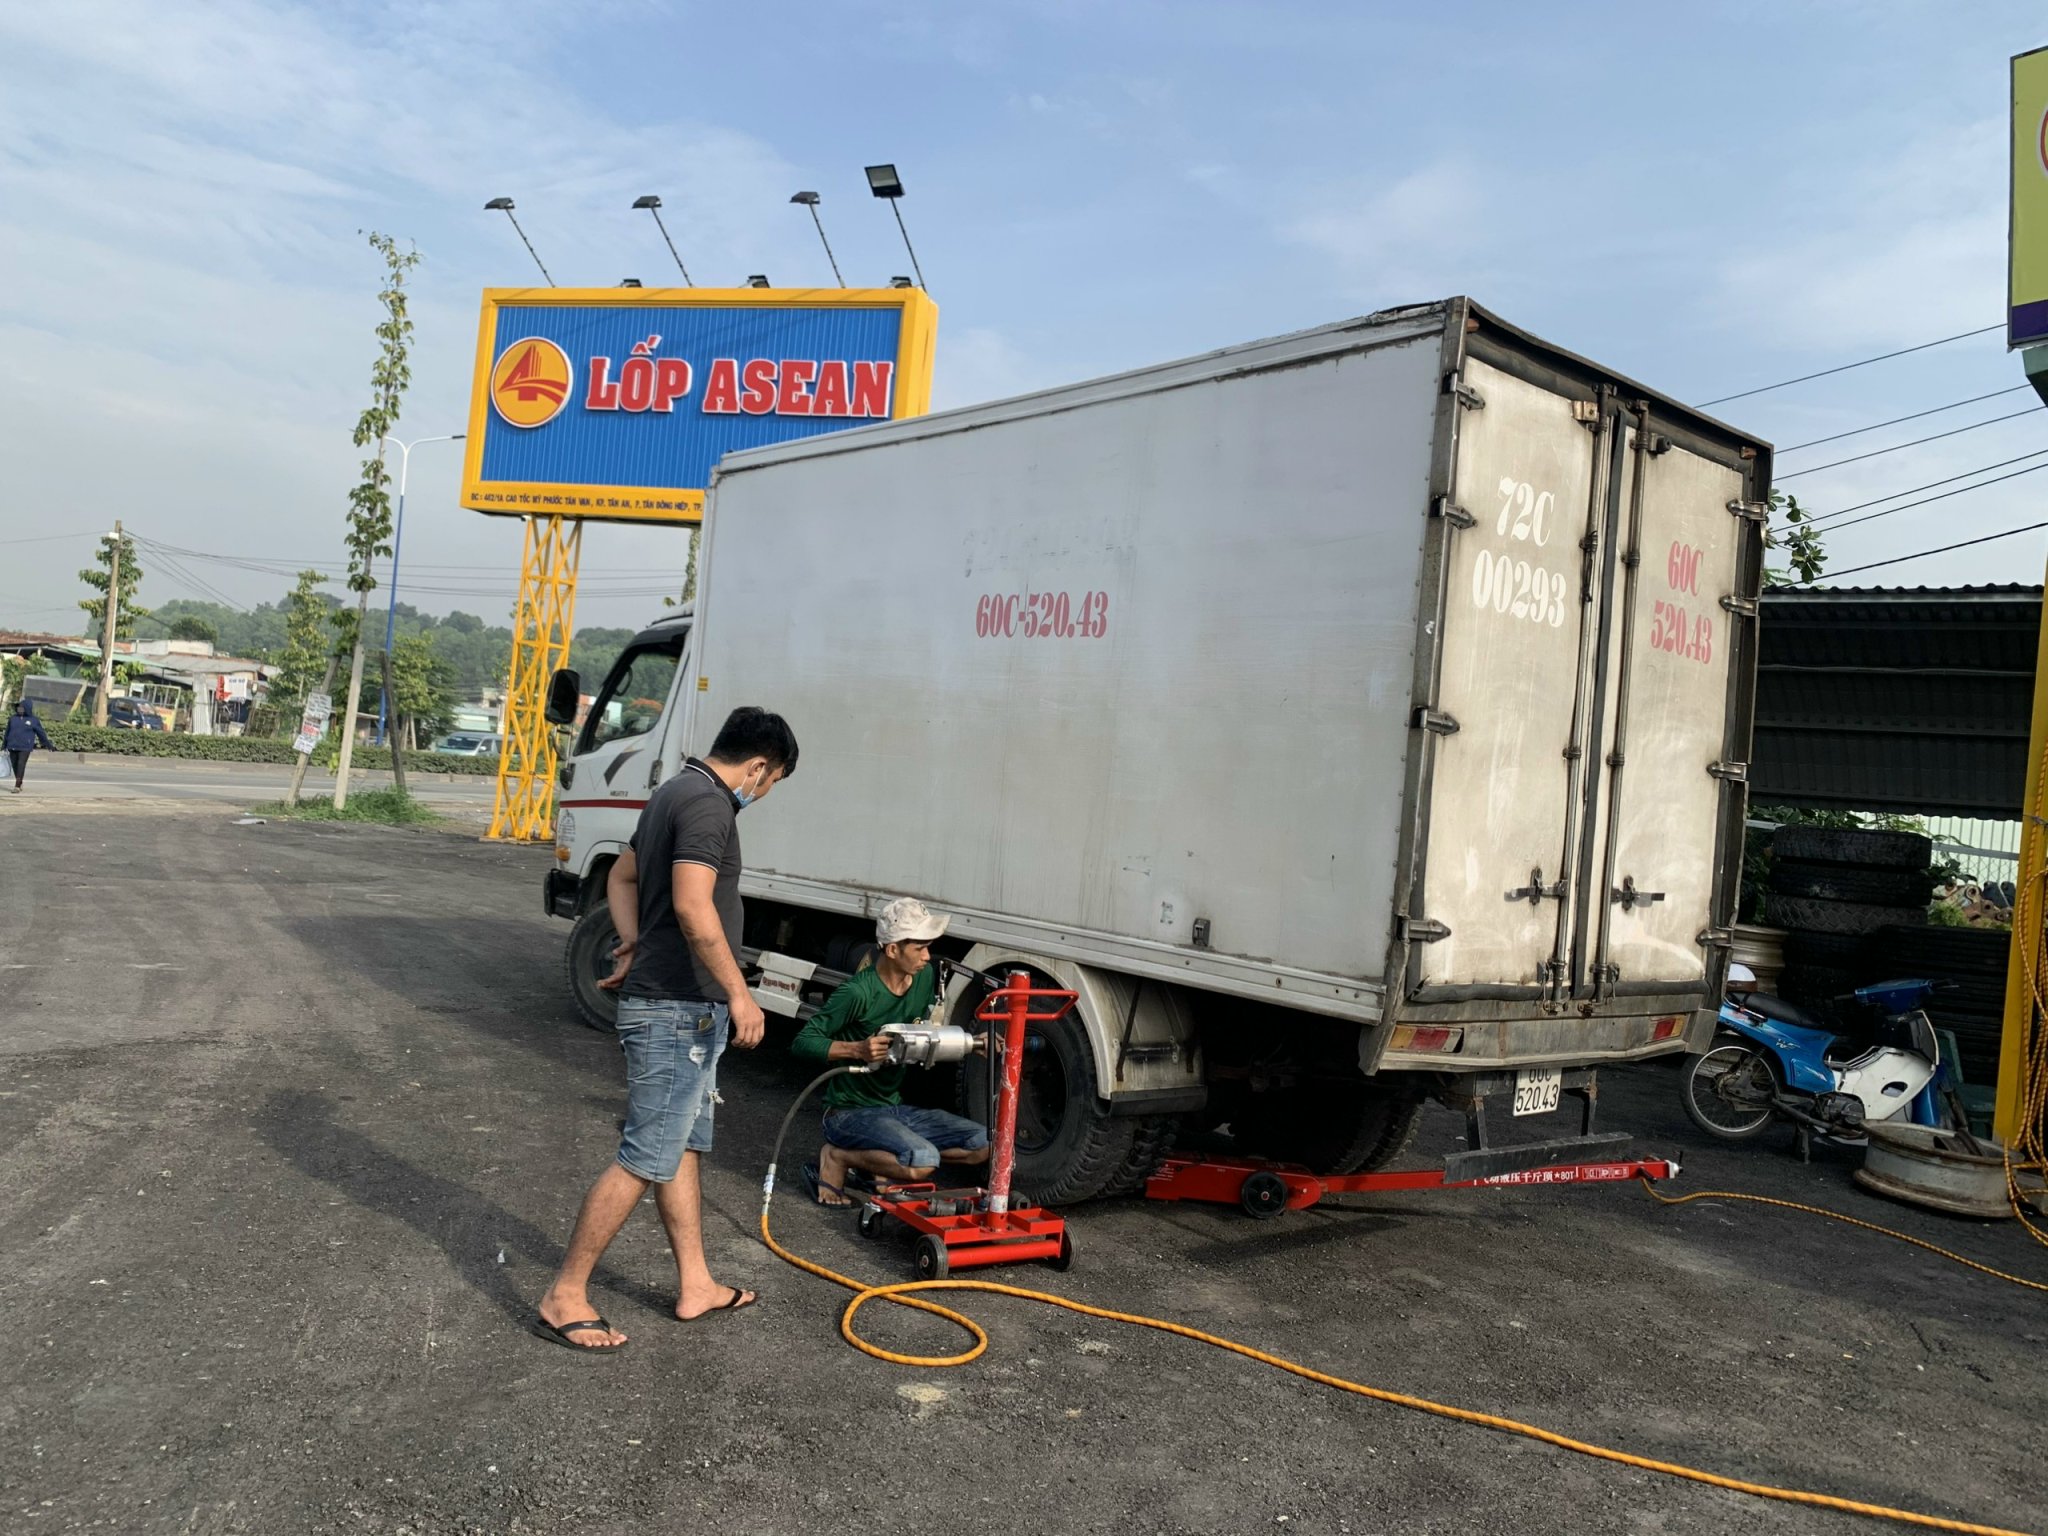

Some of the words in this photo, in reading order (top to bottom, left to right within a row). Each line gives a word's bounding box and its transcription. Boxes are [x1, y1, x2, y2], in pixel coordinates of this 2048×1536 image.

[585, 334, 693, 413] LỐP
[702, 358, 894, 418] ASEAN
[1496, 476, 1555, 546] 72C
[1472, 550, 1567, 628] 00293
[1668, 541, 1704, 596] 60C
[976, 591, 1109, 638] 60C-520.43
[1651, 600, 1712, 664] 520.43
[1516, 1084, 1559, 1112] 520.43
